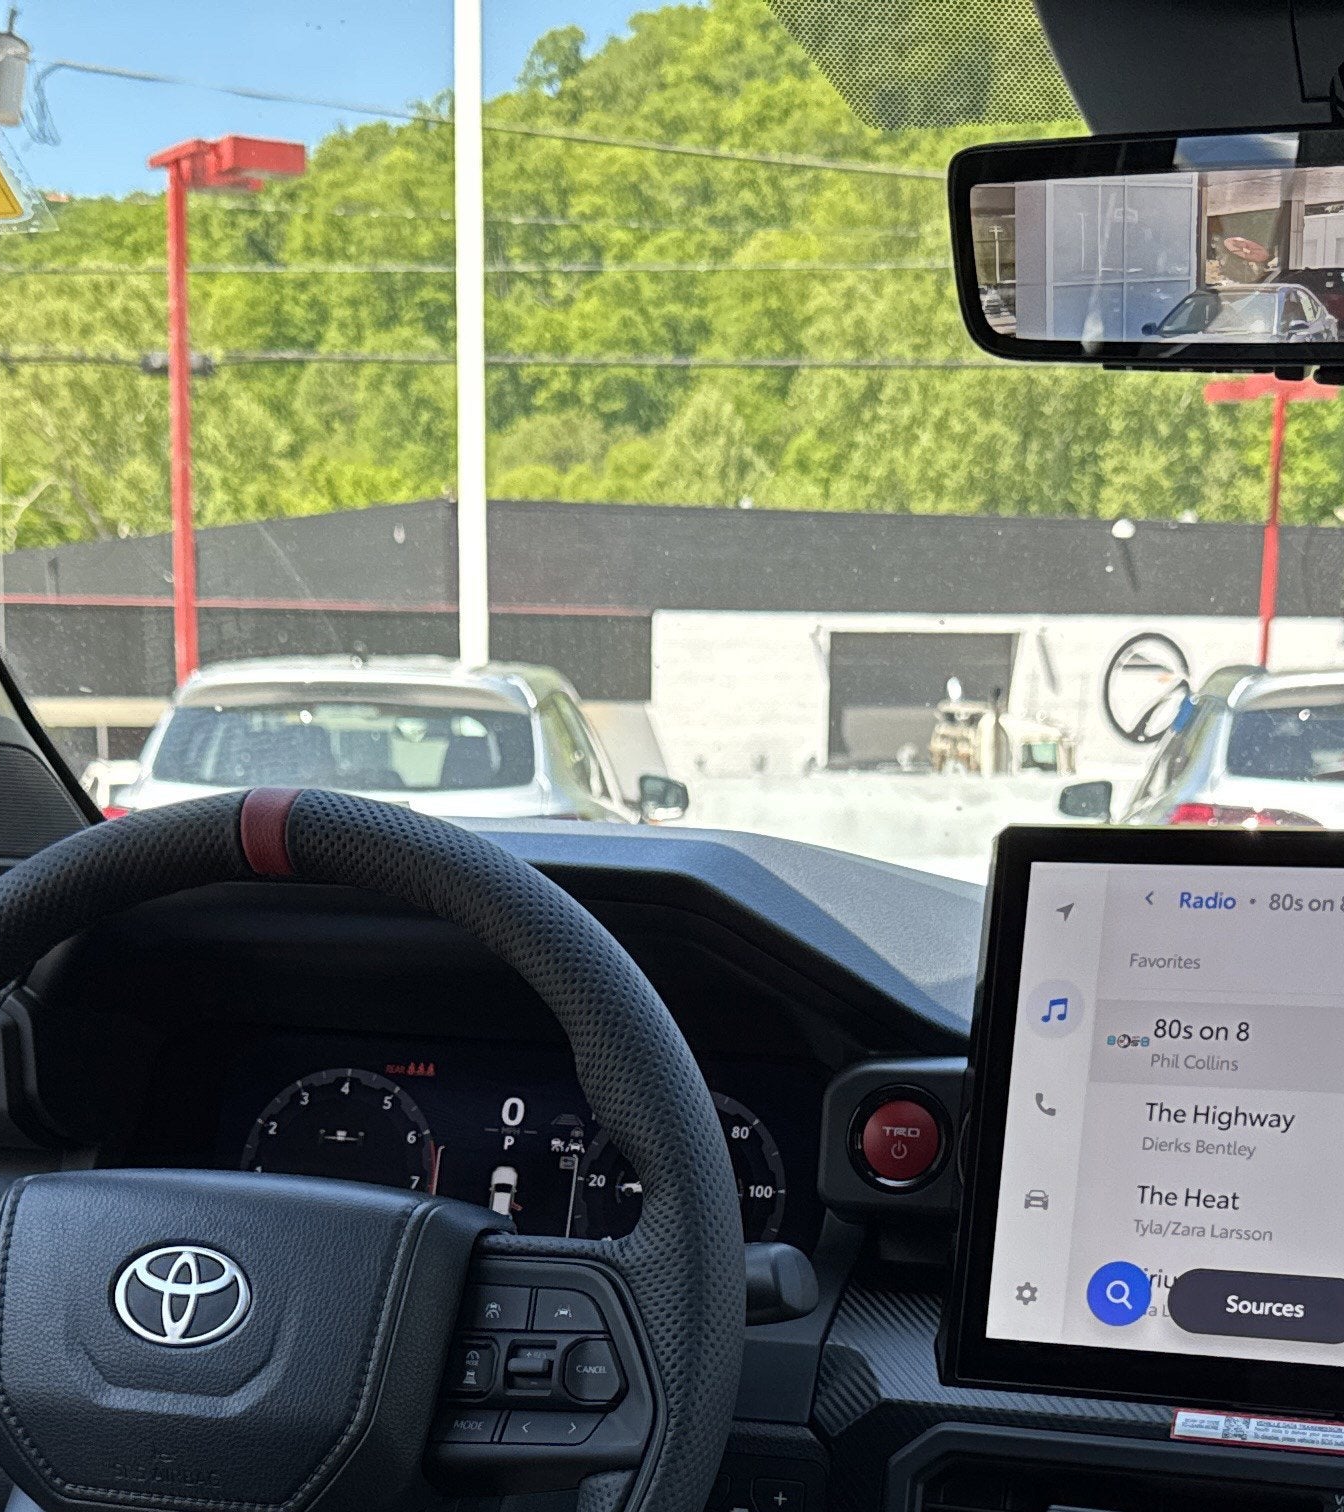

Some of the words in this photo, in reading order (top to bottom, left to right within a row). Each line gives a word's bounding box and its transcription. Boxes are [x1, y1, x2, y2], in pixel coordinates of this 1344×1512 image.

[1179, 891, 1236, 910] Radio
[1268, 893, 1303, 912] 80s
[1308, 897, 1335, 912] on
[1129, 953, 1201, 970] Favorites
[1154, 1018, 1193, 1040] 80s
[1199, 1023, 1229, 1041] on
[1236, 1022, 1250, 1041] 8
[1150, 1054, 1180, 1070] Phil
[1184, 1055, 1239, 1072] Collins
[340, 1081, 351, 1095] 4
[299, 1092, 310, 1106] 3
[382, 1095, 393, 1110] 5
[501, 1097, 525, 1126] 0
[1145, 1102, 1187, 1124] The
[1193, 1104, 1295, 1133] Highway
[268, 1121, 278, 1135] 2
[731, 1126, 750, 1141] 80
[882, 1126, 920, 1138] TRD
[407, 1131, 417, 1144] 6
[503, 1135, 515, 1150] P
[1142, 1137, 1191, 1154] Dierks
[1195, 1139, 1256, 1160] Bentley
[410, 1175, 420, 1190] 7
[588, 1174, 606, 1187] 20
[748, 1184, 773, 1199] 100
[1137, 1185, 1178, 1206] The
[1184, 1188, 1240, 1210] Heat
[1133, 1219, 1206, 1239] Tyla/Zara
[1210, 1223, 1273, 1242] Larsson
[1225, 1295, 1305, 1319] Sources
[575, 1365, 607, 1374] CANCEL
[453, 1420, 485, 1430] MODE
